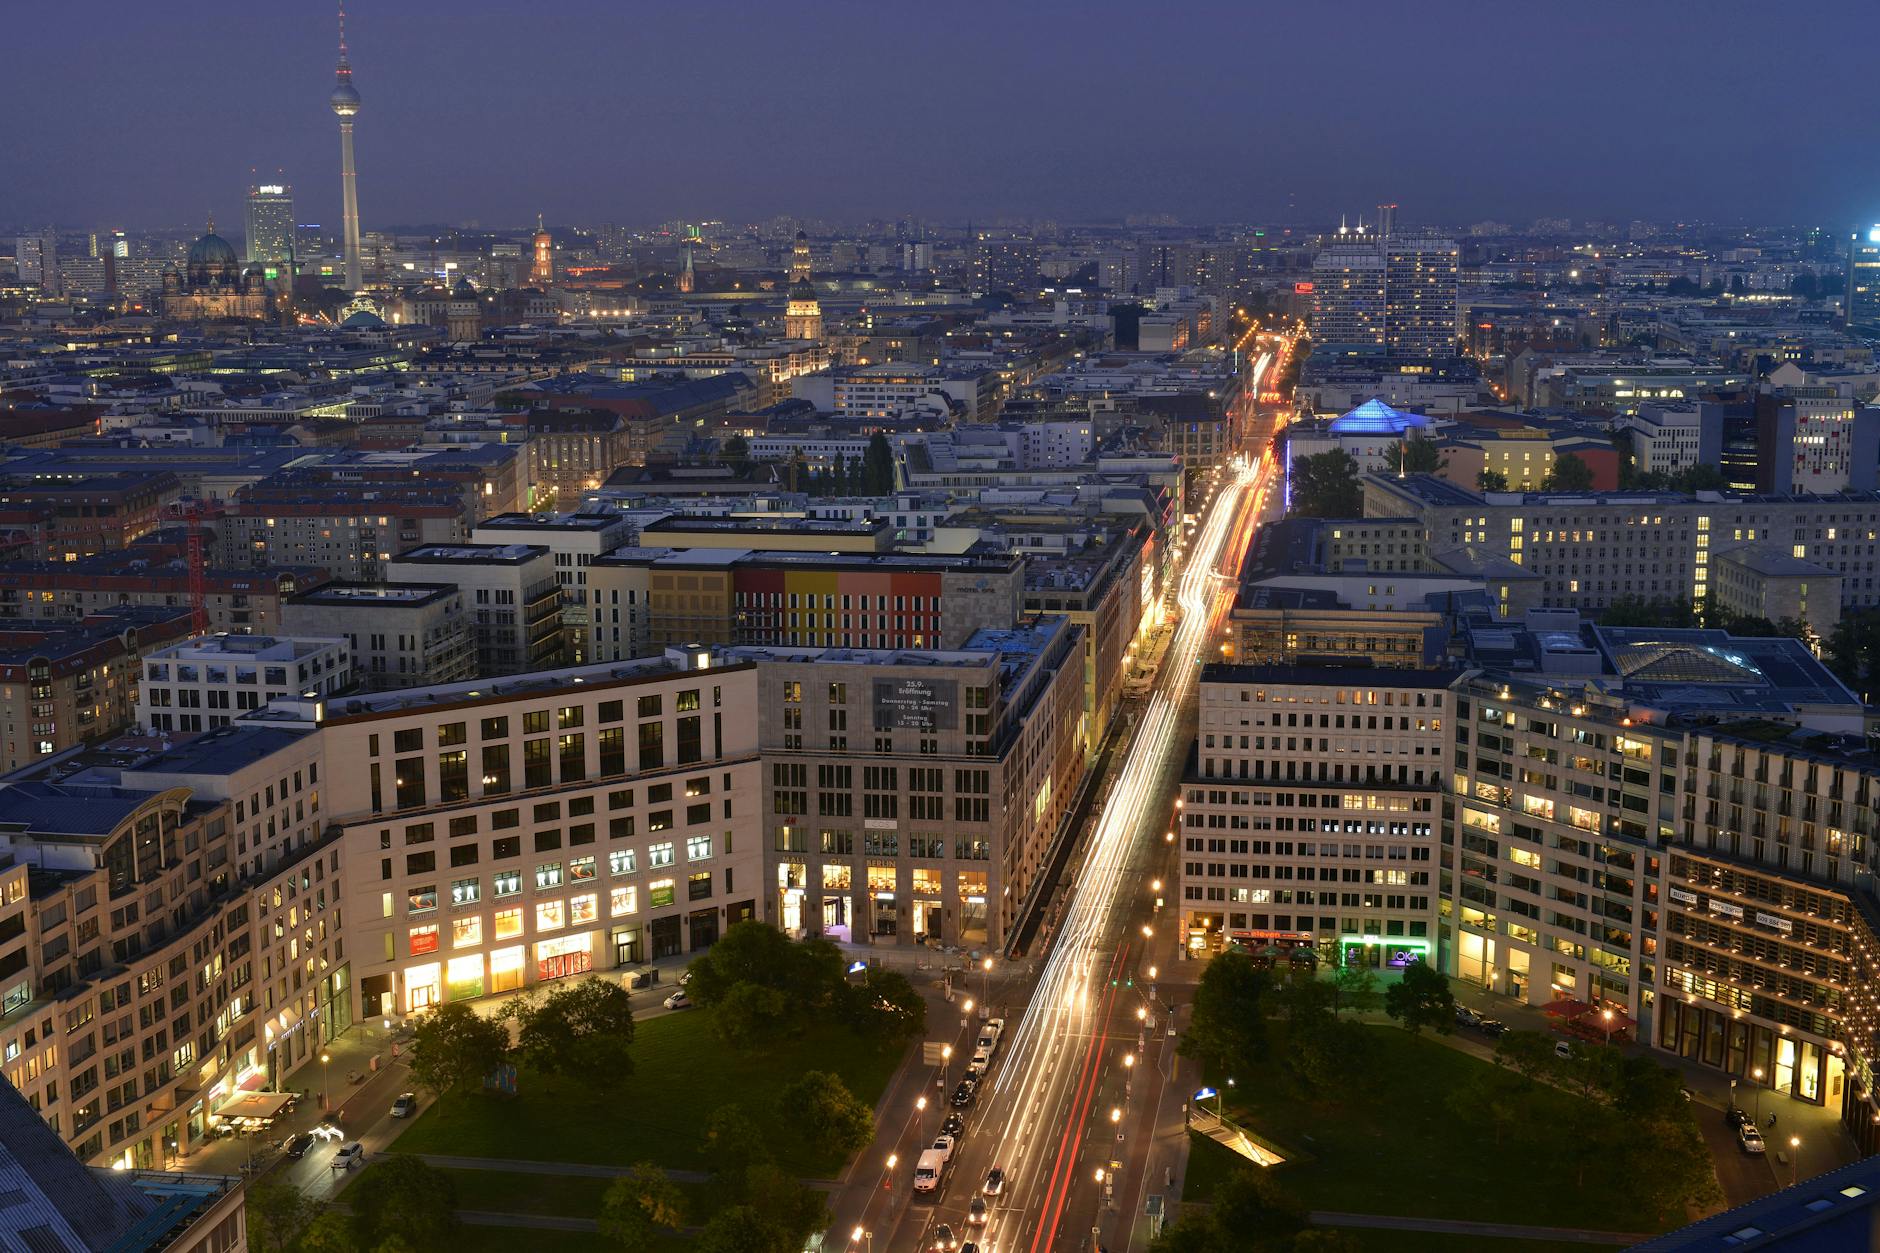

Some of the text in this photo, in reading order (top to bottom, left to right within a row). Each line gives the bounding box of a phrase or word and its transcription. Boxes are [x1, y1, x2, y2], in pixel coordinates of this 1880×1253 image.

[898, 687, 932, 697] Eröffnung
[881, 698, 917, 706] Donnerstag
[922, 699, 949, 707] Samstag
[902, 714, 928, 722] Sonntag
[782, 856, 805, 864] MALL
[866, 859, 896, 867] BERLIN
[452, 870, 559, 903] SATURN
[1392, 951, 1420, 962] JOKA
